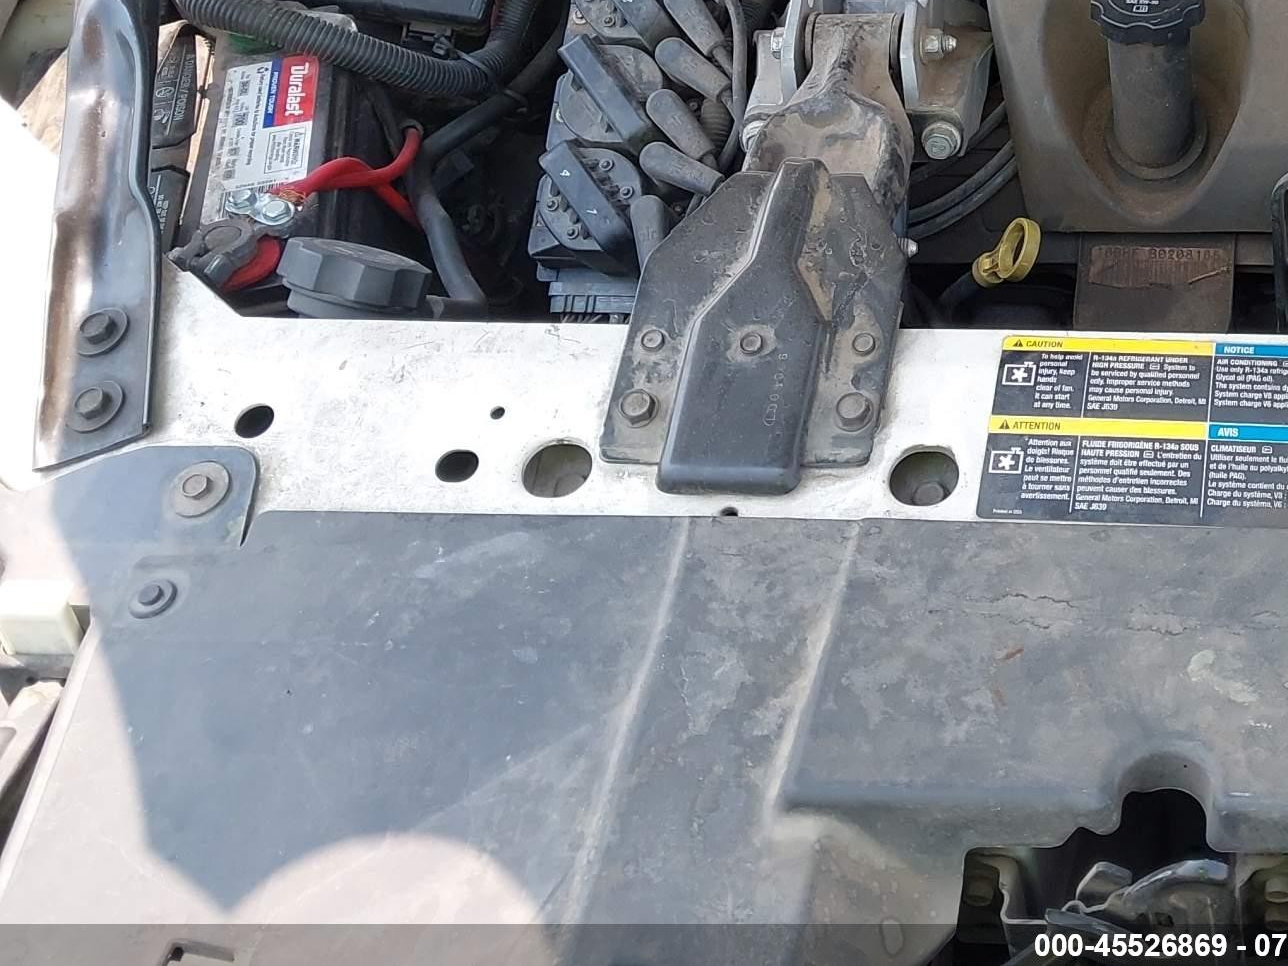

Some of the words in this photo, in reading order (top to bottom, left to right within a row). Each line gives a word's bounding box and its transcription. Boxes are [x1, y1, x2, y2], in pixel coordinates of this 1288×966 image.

[270, 71, 279, 94] PROVEN
[285, 62, 309, 116] Duralast
[174, 94, 187, 121] POISON
[267, 95, 275, 115] TOUGH
[1223, 345, 1254, 354] NOTICE
[1039, 360, 1067, 368] personal
[1038, 368, 1058, 376] injury,
[1129, 370, 1137, 378] by
[1138, 371, 1166, 379] qualified
[1167, 372, 1199, 380] personnel
[1106, 378, 1135, 386] Improper
[1215, 374, 1235, 382] Glycol
[1124, 387, 1153, 395] personal
[1228, 382, 1251, 391] system
[1214, 391, 1238, 399] System
[1239, 391, 1262, 400] charge
[1213, 399, 1237, 408] System
[1239, 400, 1261, 408] charge
[1013, 421, 1060, 430] ATTENTION
[1217, 427, 1239, 436] AVIS
[1028, 438, 1057, 446] Attention
[1081, 439, 1106, 448] FLUIDE
[1154, 442, 1178, 450] R-134a
[1179, 442, 1199, 450] SOUS
[1051, 448, 1074, 456] Risque
[1210, 444, 1256, 452] CLIMATISEUR
[1104, 449, 1139, 457] PRESSION
[1033, 465, 1070, 473] ventilateur
[1078, 467, 1112, 476] personnel
[1022, 474, 1039, 482] peut
[1208, 472, 1227, 480] (huile
[1028, 482, 1053, 490] tourner
[1149, 478, 1187, 486] incorrectes
[1247, 481, 1274, 489] contient
[1076, 485, 1101, 494] peuvent
[1207, 489, 1231, 498] Charge
[1075, 493, 1100, 501] General
[1101, 494, 1124, 502] Motors
[1206, 498, 1230, 507] Charge
